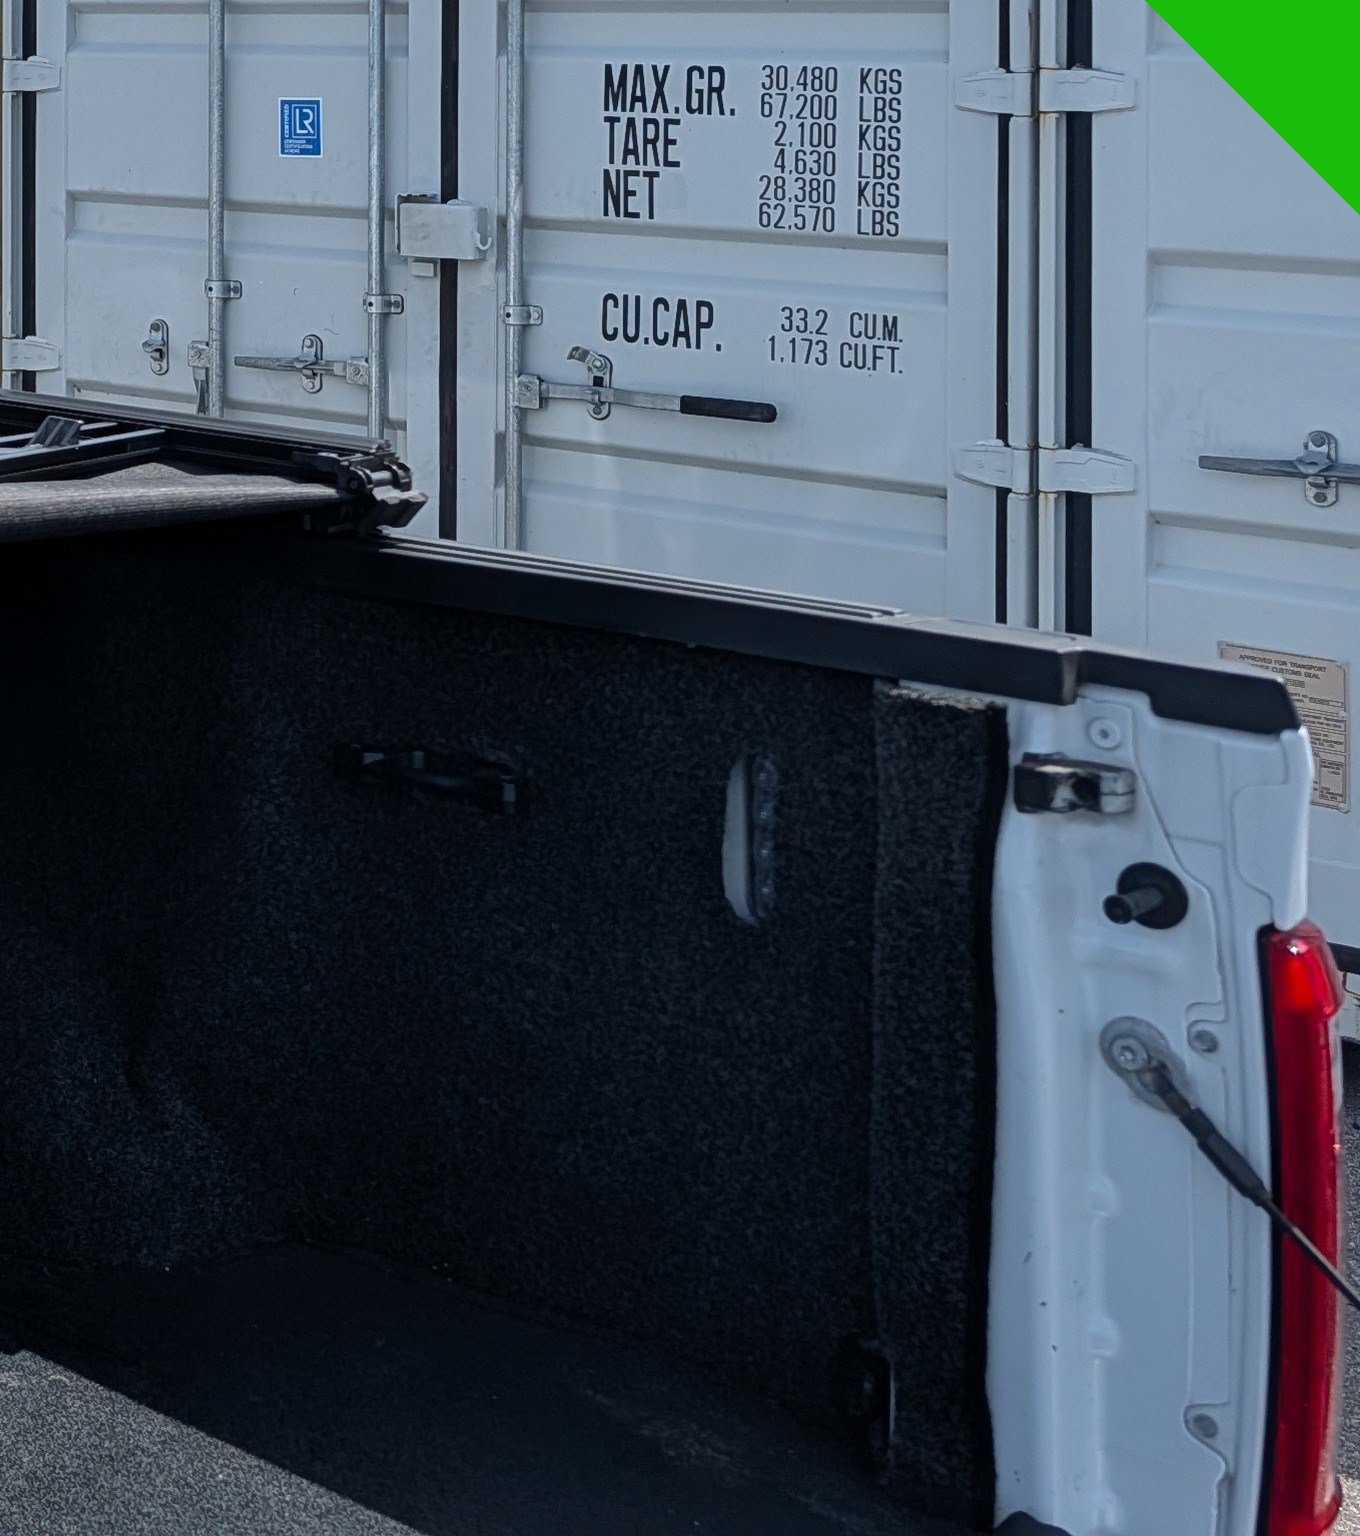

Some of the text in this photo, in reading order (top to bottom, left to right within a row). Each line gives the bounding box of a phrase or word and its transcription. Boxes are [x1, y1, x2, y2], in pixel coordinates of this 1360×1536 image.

[859, 67, 902, 95] KGS
[858, 96, 902, 123] LBS
[603, 116, 681, 168] TARE
[858, 124, 901, 152] KGS
[857, 152, 901, 180] LBS
[602, 169, 660, 219] NET
[857, 181, 900, 208] KGS
[856, 209, 900, 237] LBS
[780, 306, 828, 335] 33.2
